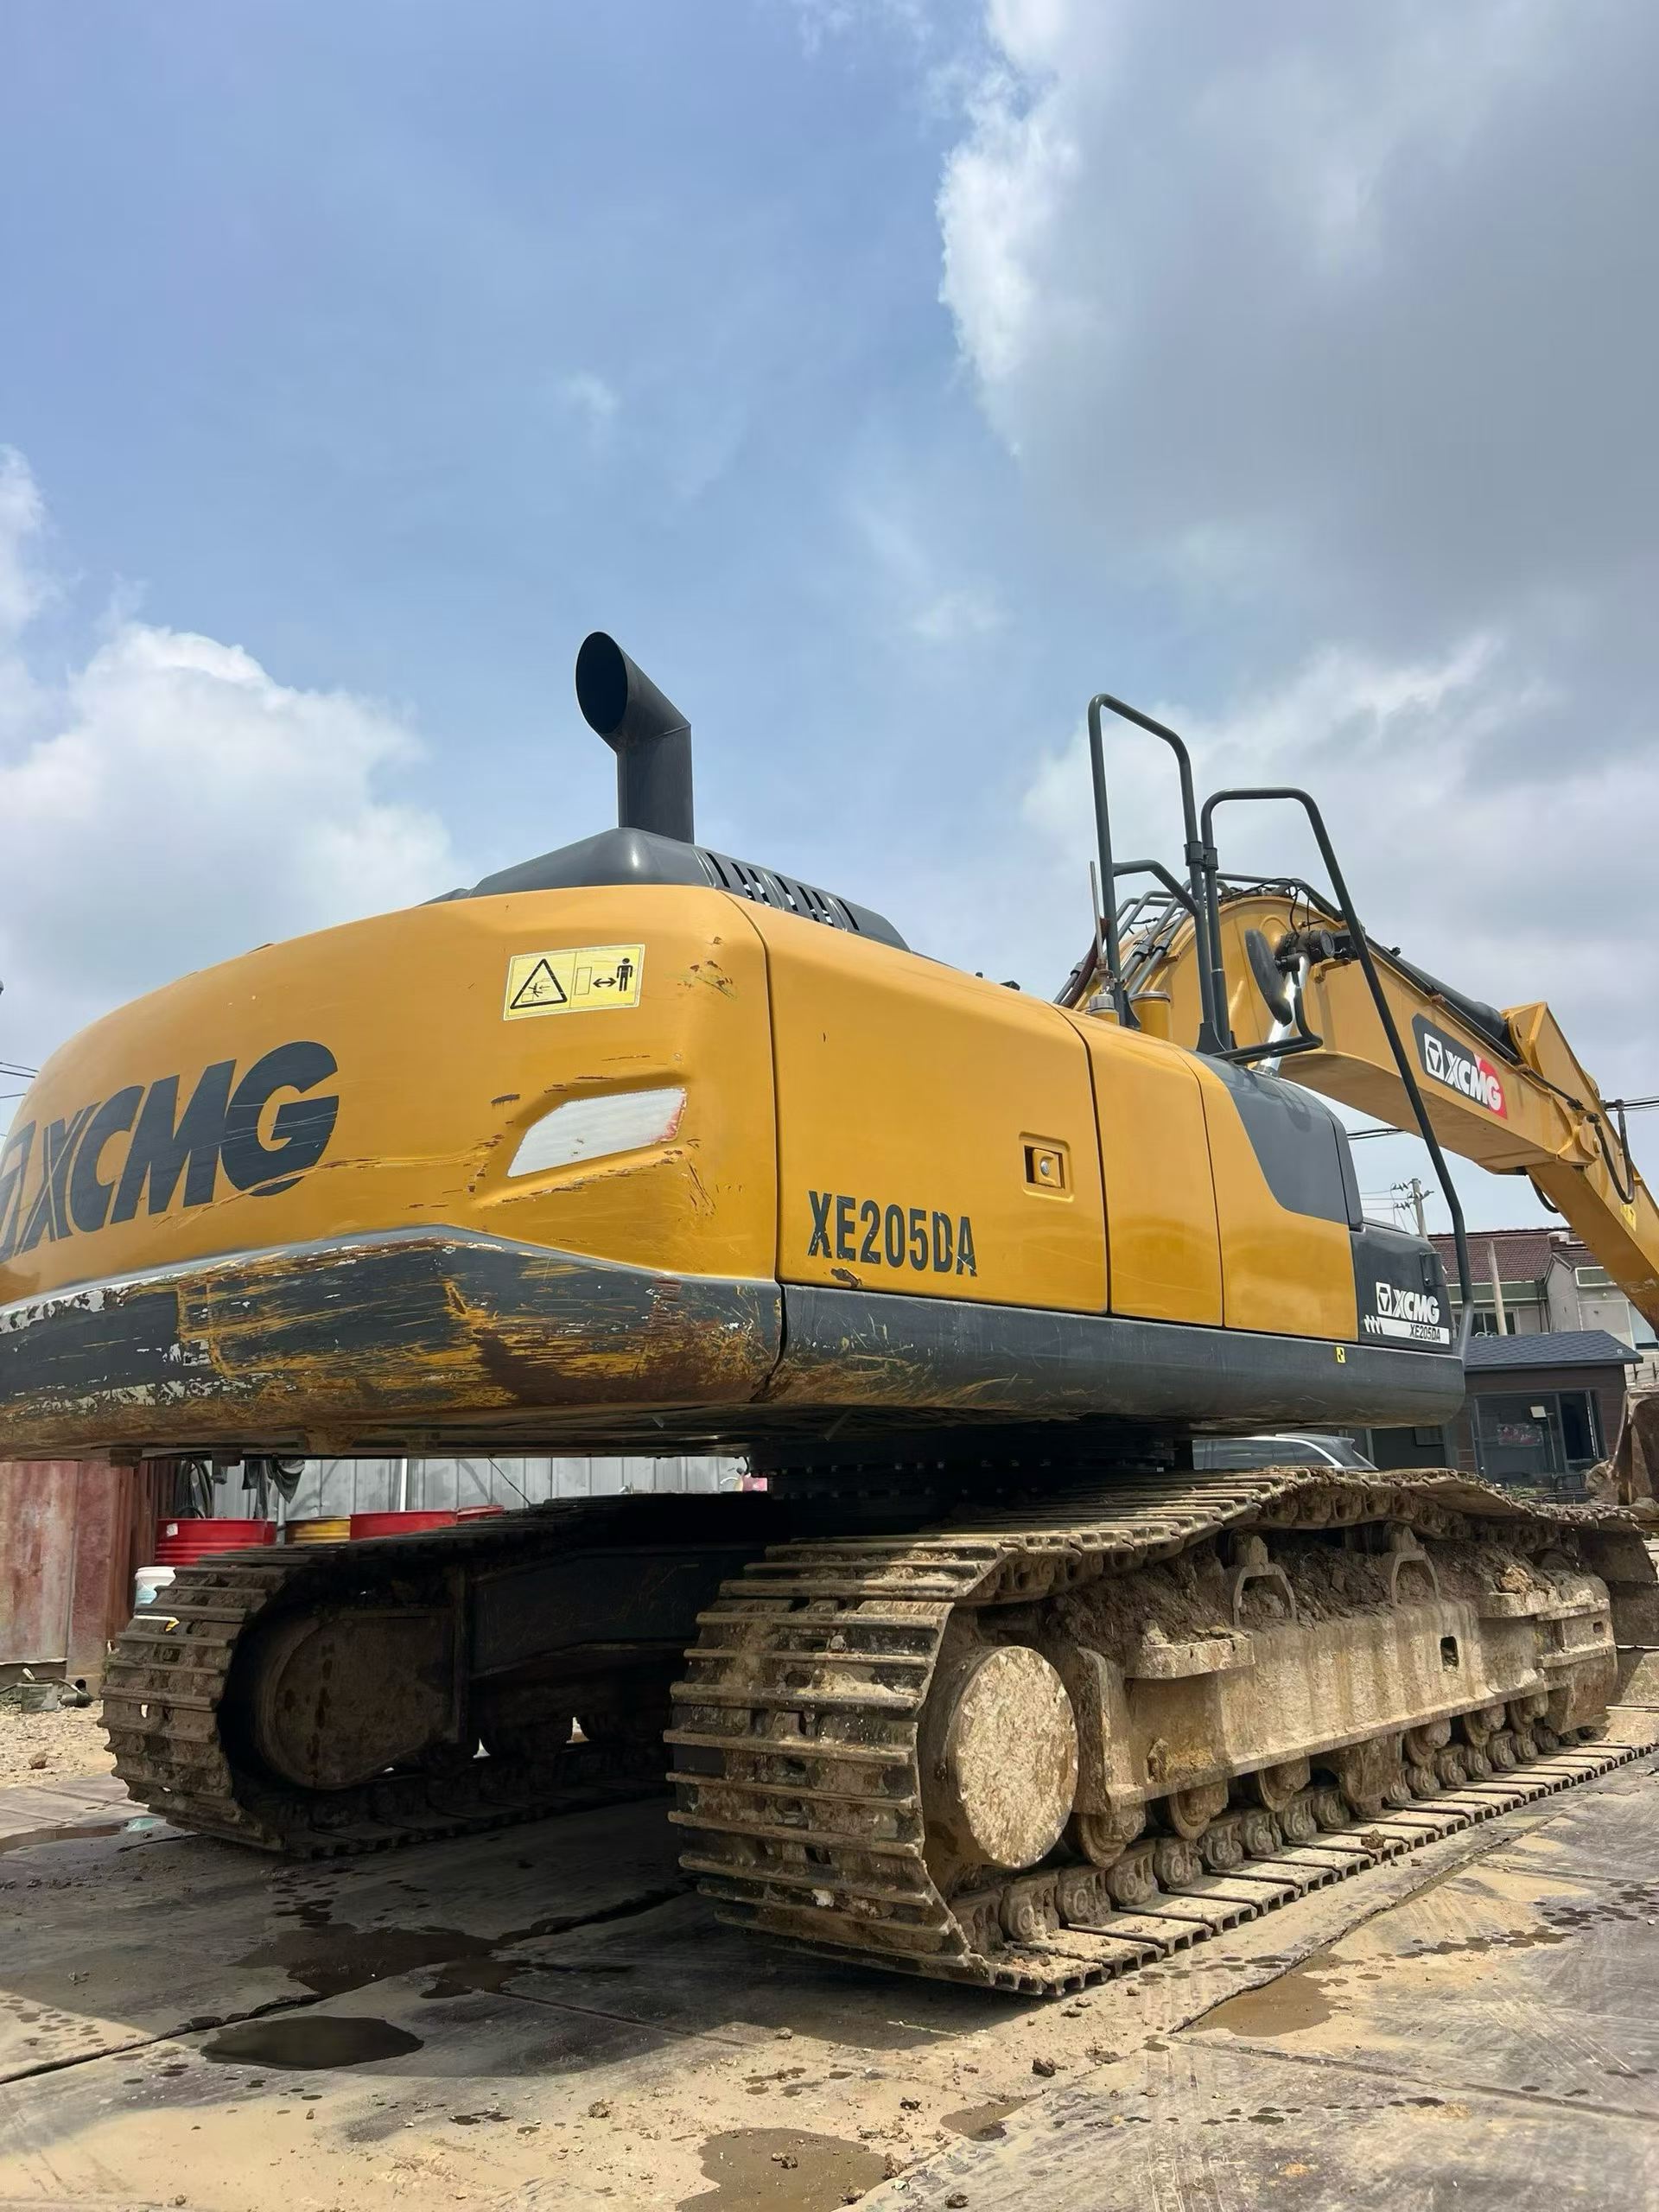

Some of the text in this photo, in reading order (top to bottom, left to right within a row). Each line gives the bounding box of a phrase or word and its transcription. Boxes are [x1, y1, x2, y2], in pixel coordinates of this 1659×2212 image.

[1445, 1050, 1502, 1110] XCMG
[17, 1041, 340, 1255] XCMG
[808, 1191, 977, 1276] XE205DA
[1392, 1289, 1440, 1323] XCMG
[1410, 1325, 1440, 1341] XE205DA
